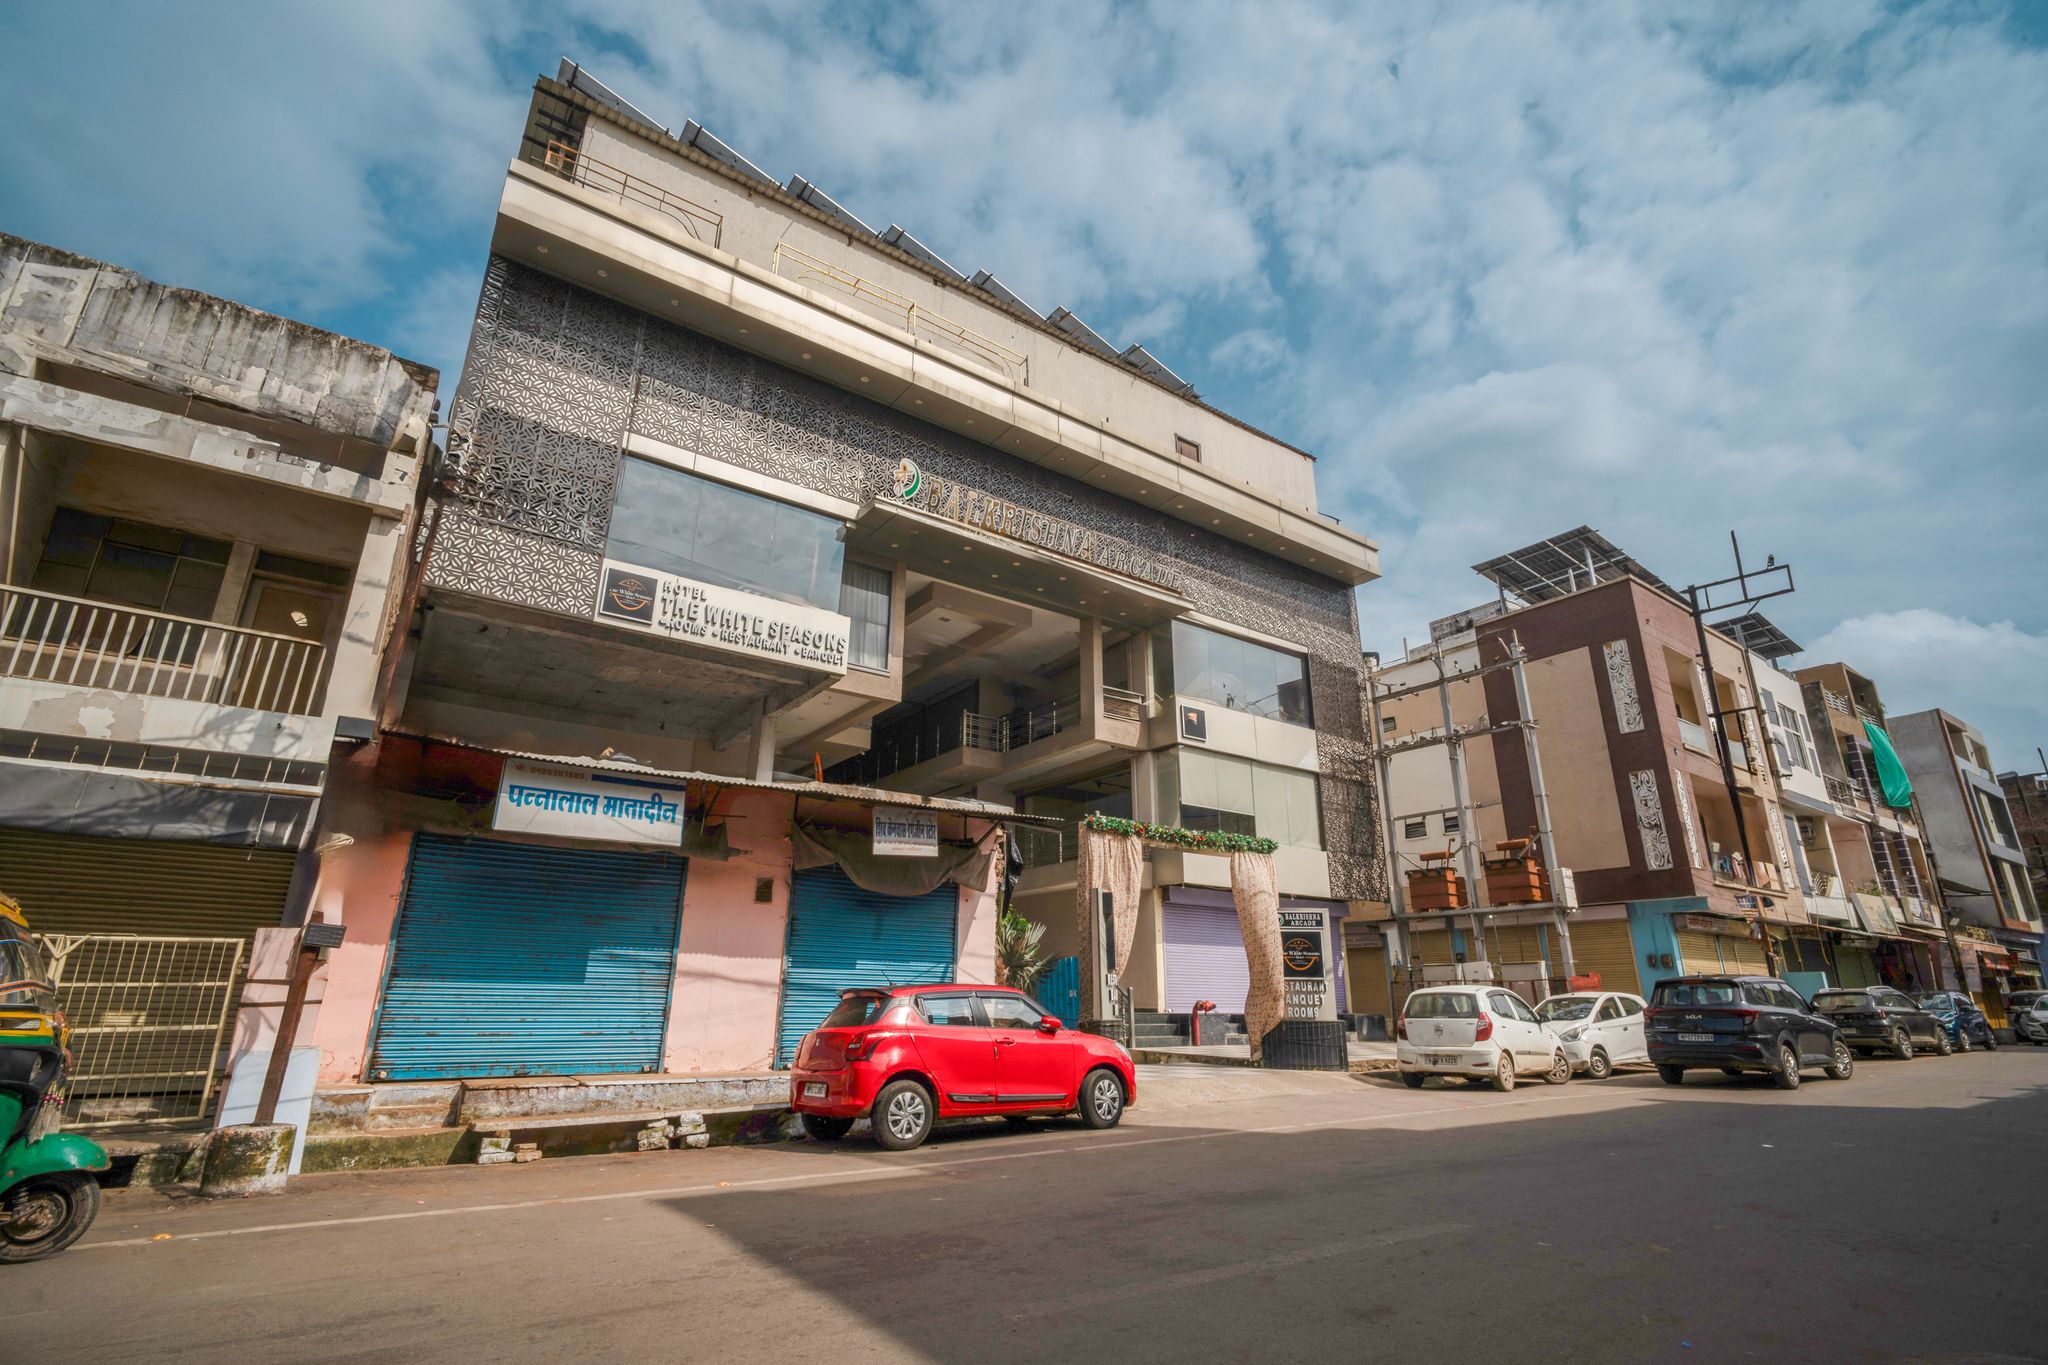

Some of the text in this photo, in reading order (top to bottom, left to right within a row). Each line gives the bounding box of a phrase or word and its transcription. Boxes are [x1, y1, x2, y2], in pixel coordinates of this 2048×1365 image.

[926, 478, 1183, 589] BALKRISHNA ARCADE
[662, 580, 707, 601] HOTEL
[661, 595, 847, 654] THE WHITE SEASONS
[719, 629, 790, 656] RESTAURANT
[508, 784, 679, 824] पन्नालाल मातादीन
[1285, 913, 1321, 921] BALKRISHNA
[1284, 981, 1329, 992] STAURANT
[1286, 994, 1326, 1006] ANQUET
[1288, 1007, 1319, 1018] ROOMS
